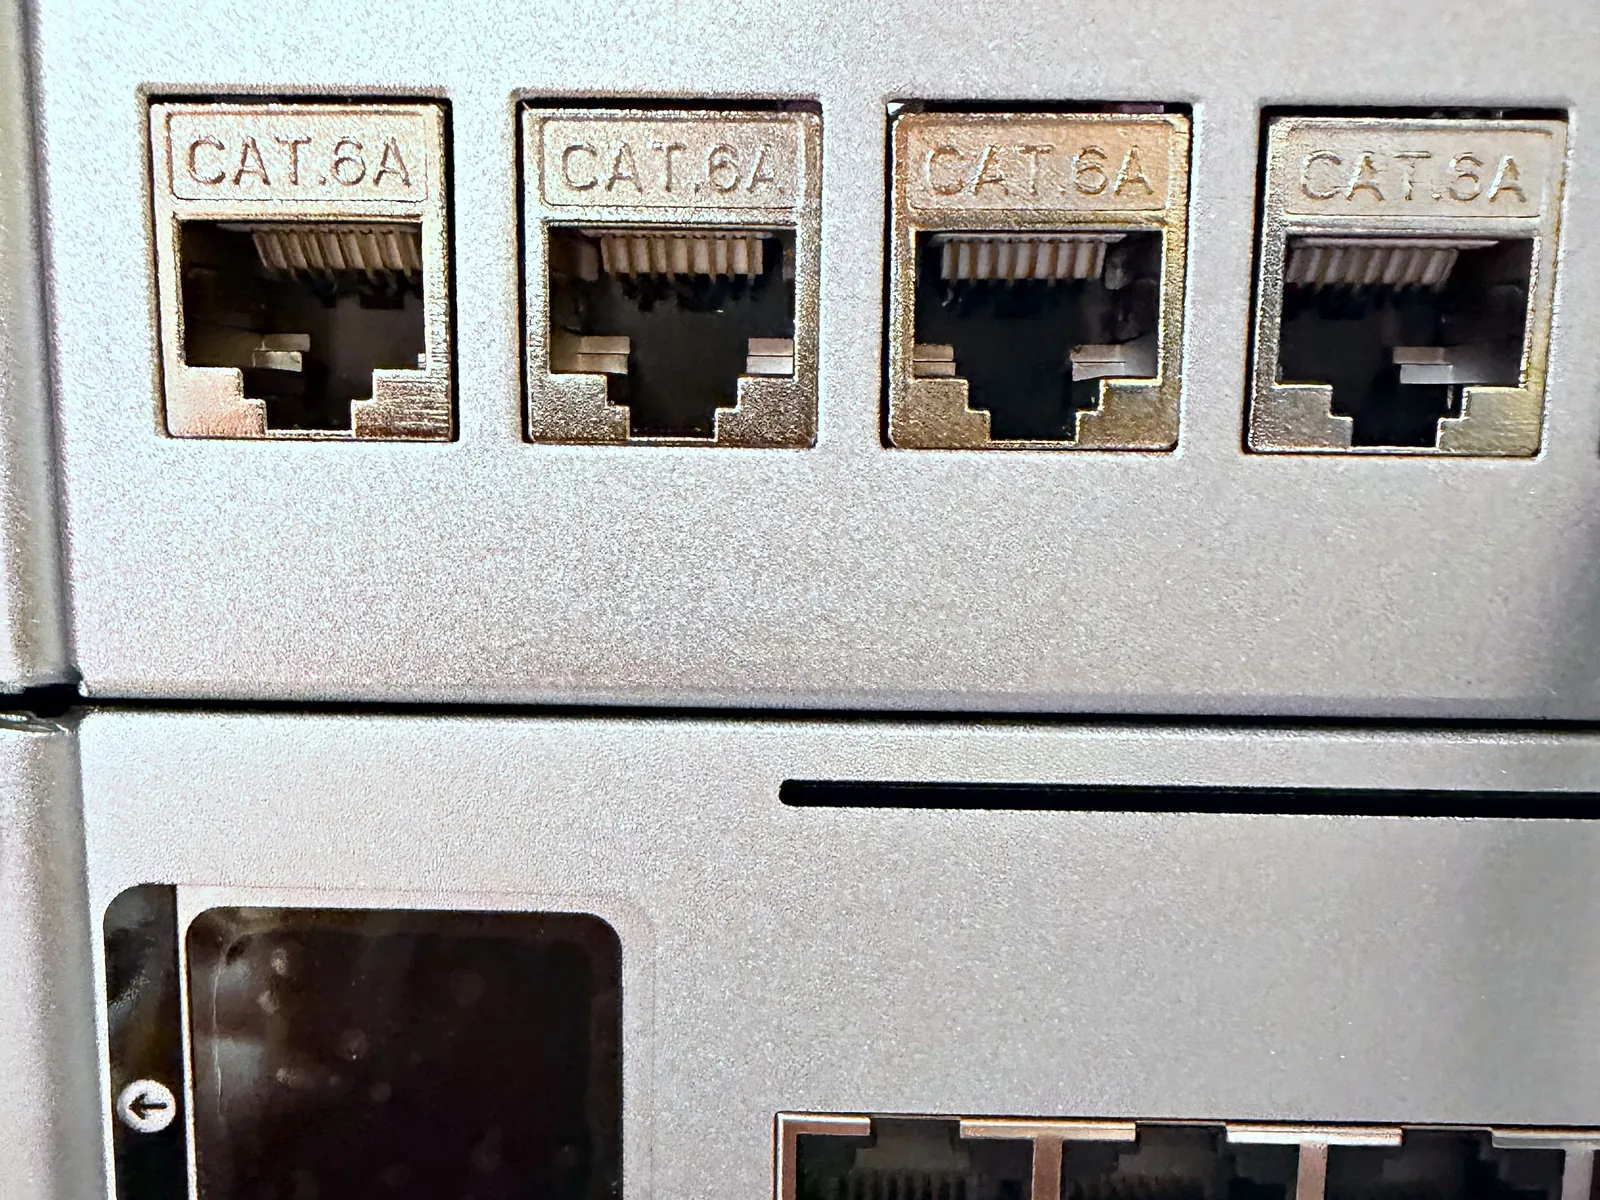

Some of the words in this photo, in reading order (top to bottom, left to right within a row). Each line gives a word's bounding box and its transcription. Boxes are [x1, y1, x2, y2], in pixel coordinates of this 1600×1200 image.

[186, 135, 411, 187] CAT.6A
[561, 141, 786, 193] CAT.6A
[925, 144, 1154, 196] CAT.6A
[1300, 150, 1526, 202] CAT.6A
